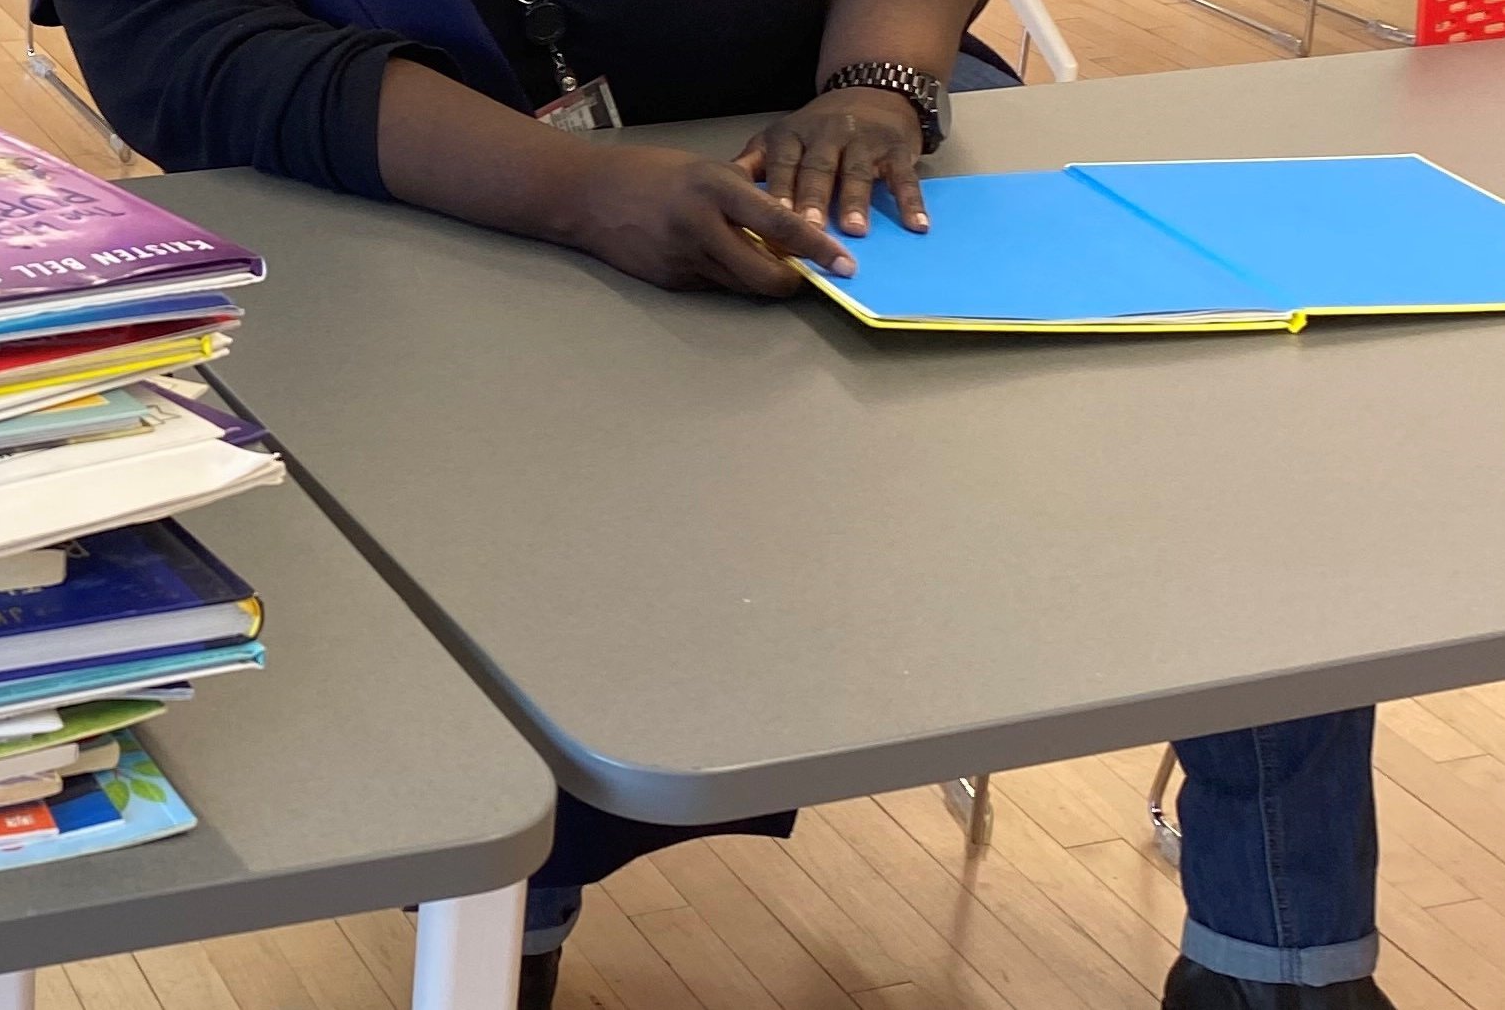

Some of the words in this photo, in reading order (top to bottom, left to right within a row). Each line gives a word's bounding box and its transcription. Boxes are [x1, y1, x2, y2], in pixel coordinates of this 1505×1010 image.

[58, 206, 126, 221] The
[90, 240, 214, 266] KRISTEN
[10, 257, 87, 278] BELL
